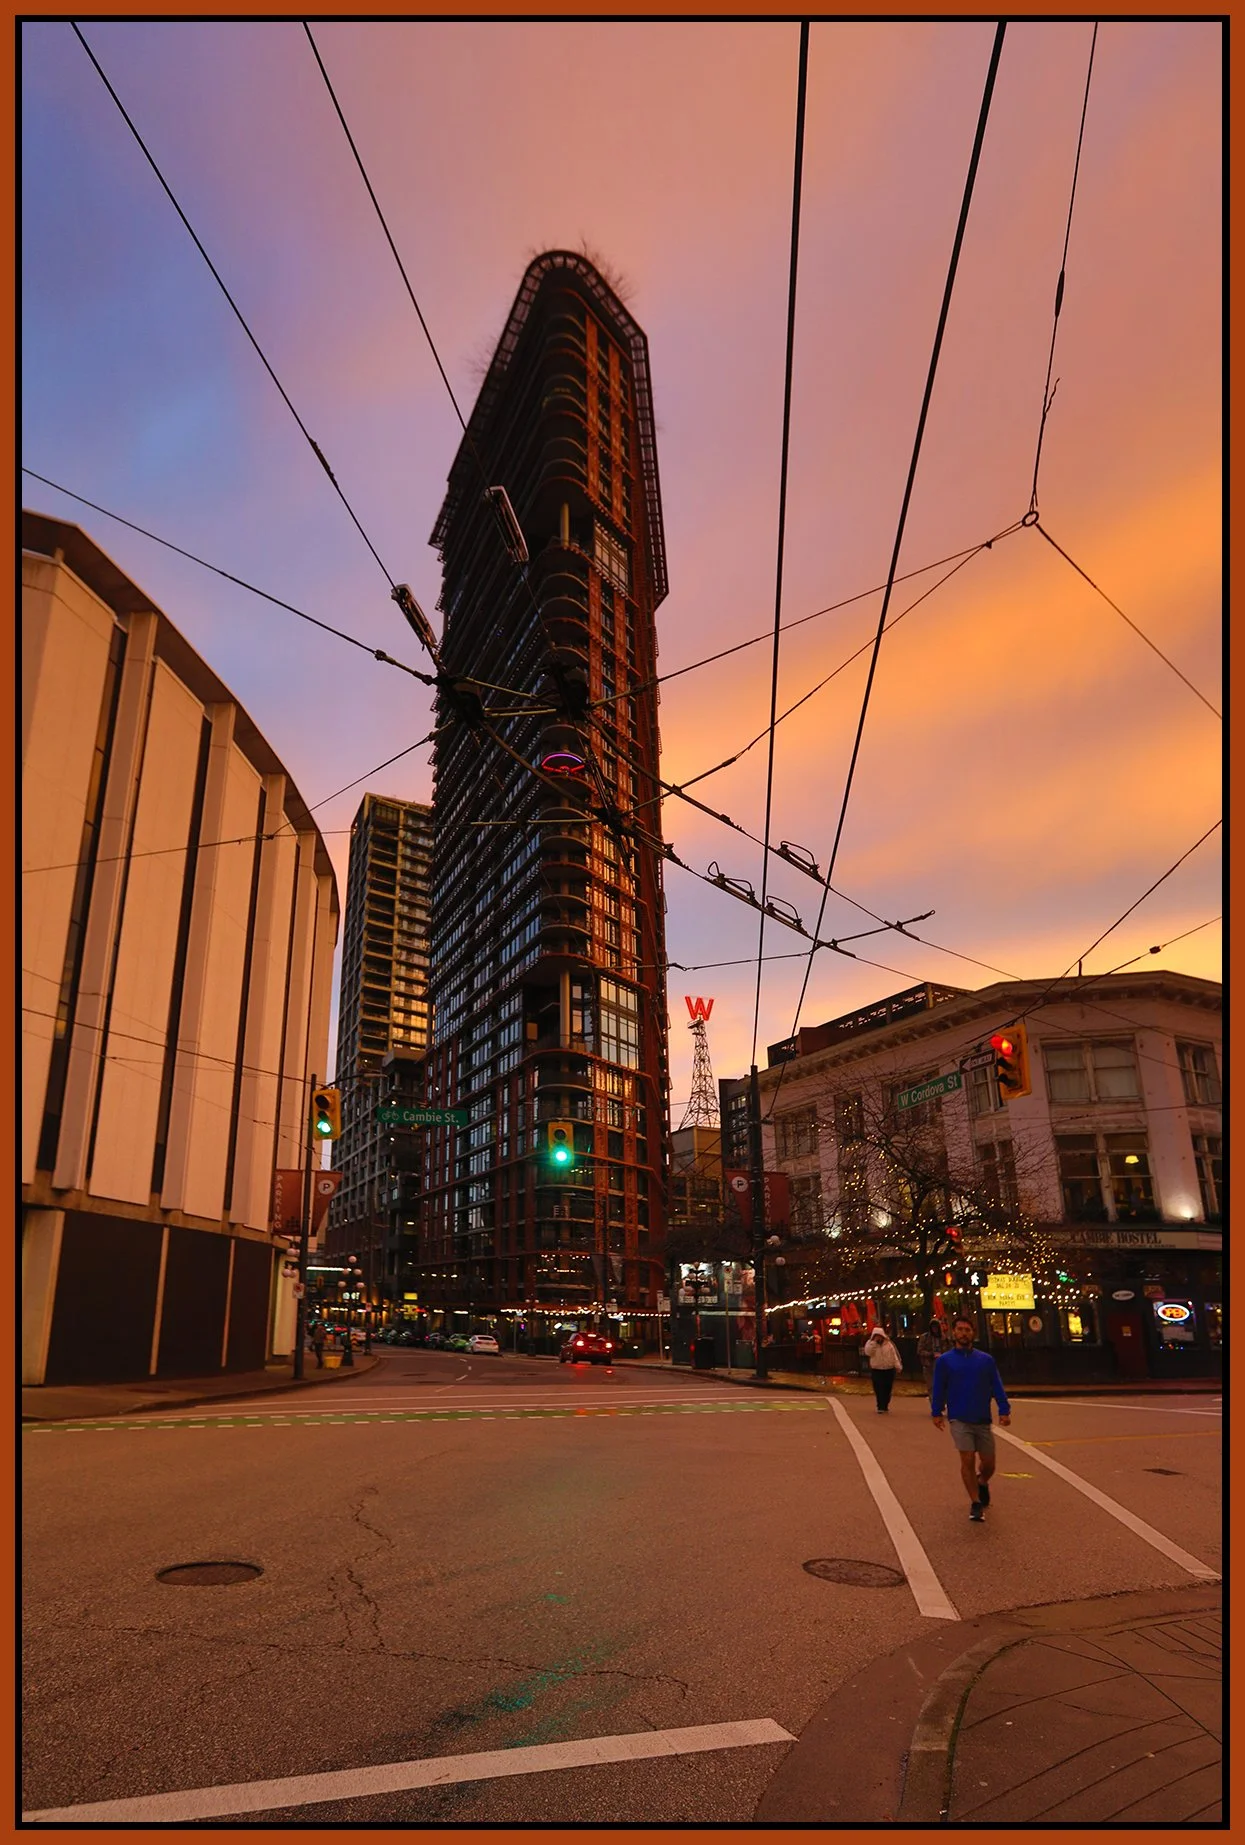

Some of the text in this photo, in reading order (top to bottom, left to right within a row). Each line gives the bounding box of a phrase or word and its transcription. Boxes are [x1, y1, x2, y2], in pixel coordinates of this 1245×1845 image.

[685, 996, 714, 1021] W
[901, 1073, 957, 1106] W Cordova St
[403, 1111, 459, 1123] Cambie St.
[274, 1175, 283, 1229] PARKING
[1116, 1232, 1161, 1244] HOSTEL
[1161, 1307, 1187, 1318] OPEN
